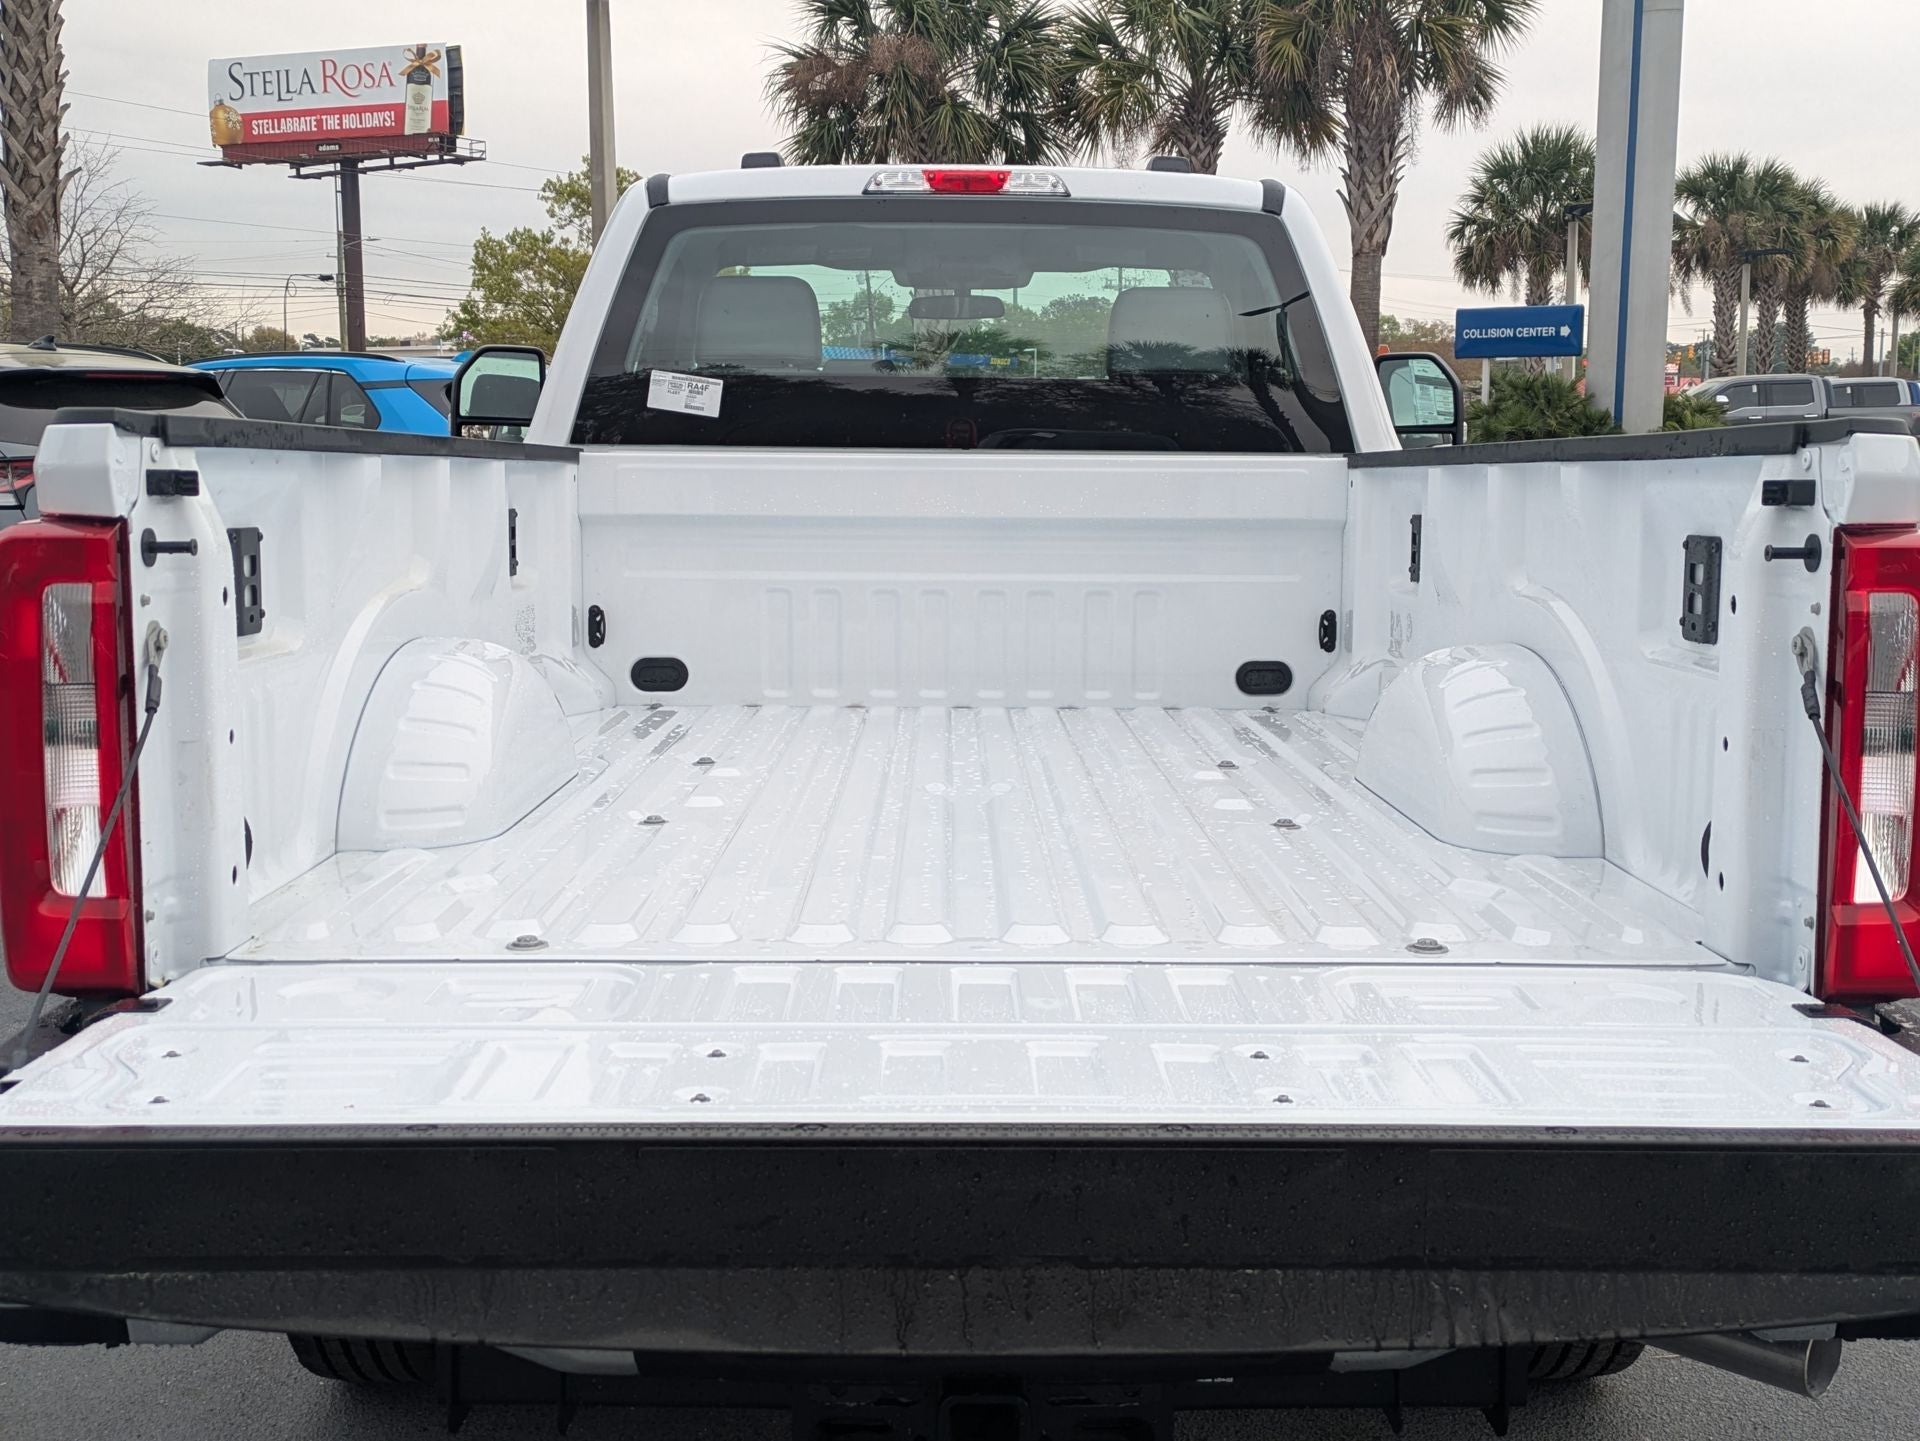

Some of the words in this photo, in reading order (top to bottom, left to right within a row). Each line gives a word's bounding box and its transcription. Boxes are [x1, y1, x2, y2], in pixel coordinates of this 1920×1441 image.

[321, 115, 341, 132] THE
[342, 110, 396, 130] HOLIDAYS!
[318, 144, 340, 152] adams
[1463, 328, 1514, 339] COLLISION
[1516, 327, 1556, 338] CENTER
[687, 382, 710, 391] RA4F
